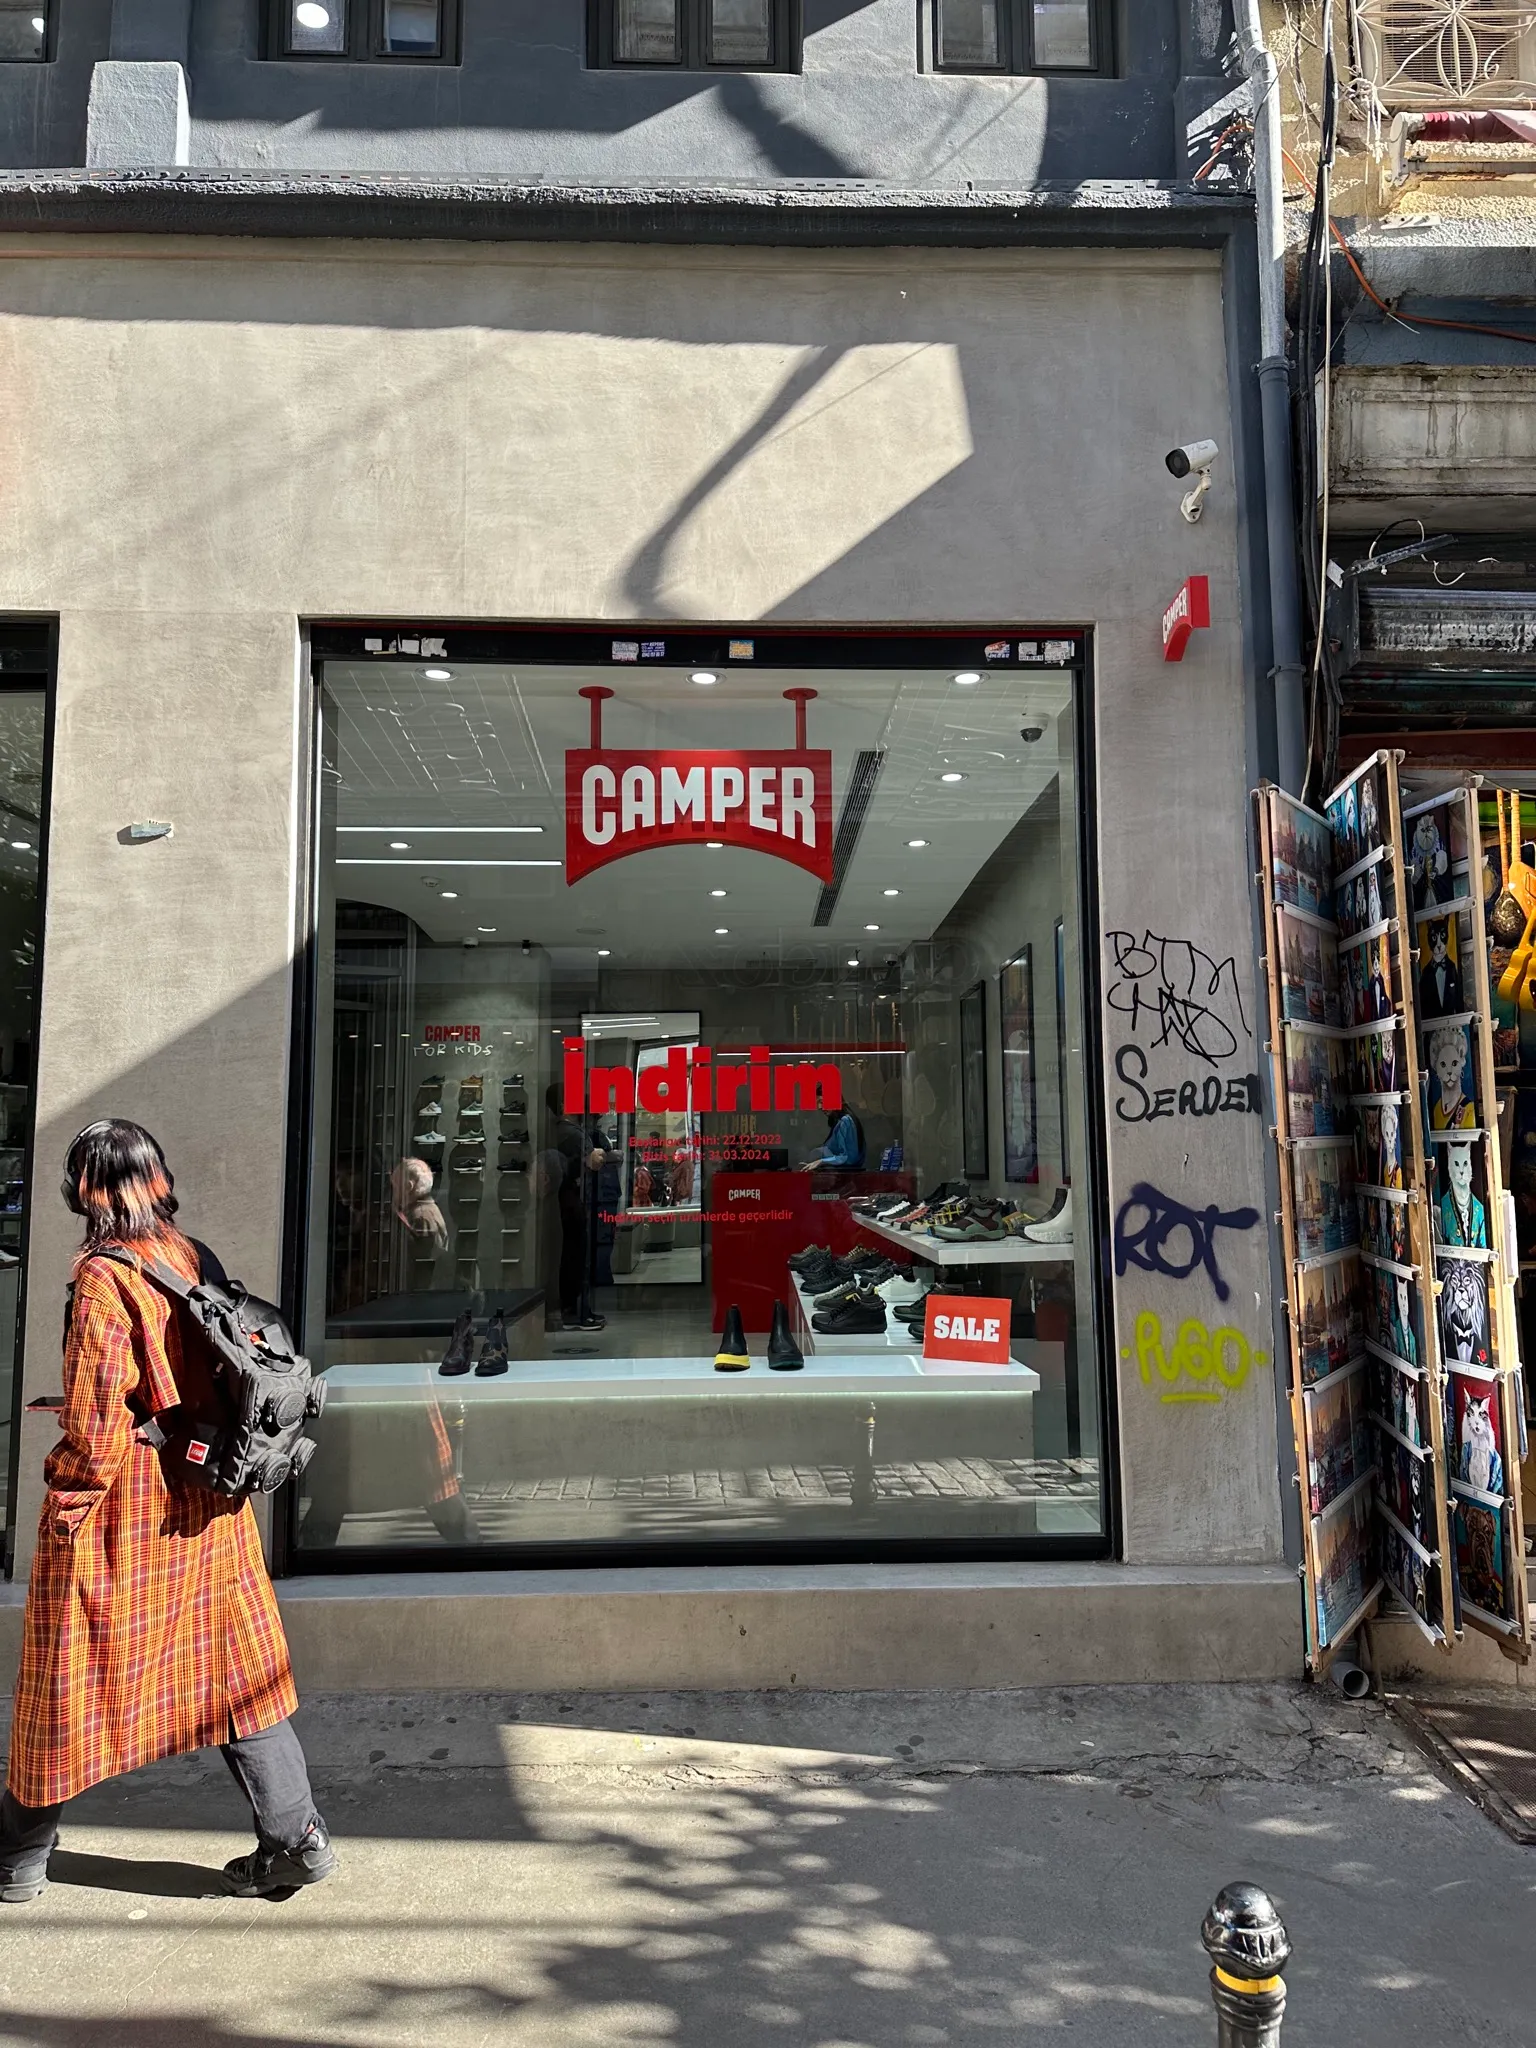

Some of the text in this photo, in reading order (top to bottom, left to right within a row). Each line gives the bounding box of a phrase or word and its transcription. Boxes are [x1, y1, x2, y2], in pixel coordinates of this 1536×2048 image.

[1162, 587, 1188, 644] CAMPER
[581, 764, 816, 849] CAMPER
[425, 1025, 480, 1042] CAMPER
[563, 1036, 842, 1114] İndirim
[709, 1149, 770, 1161] 31.03.2024
[728, 1188, 761, 1201] CAMPER
[934, 1315, 1000, 1343] SALE
